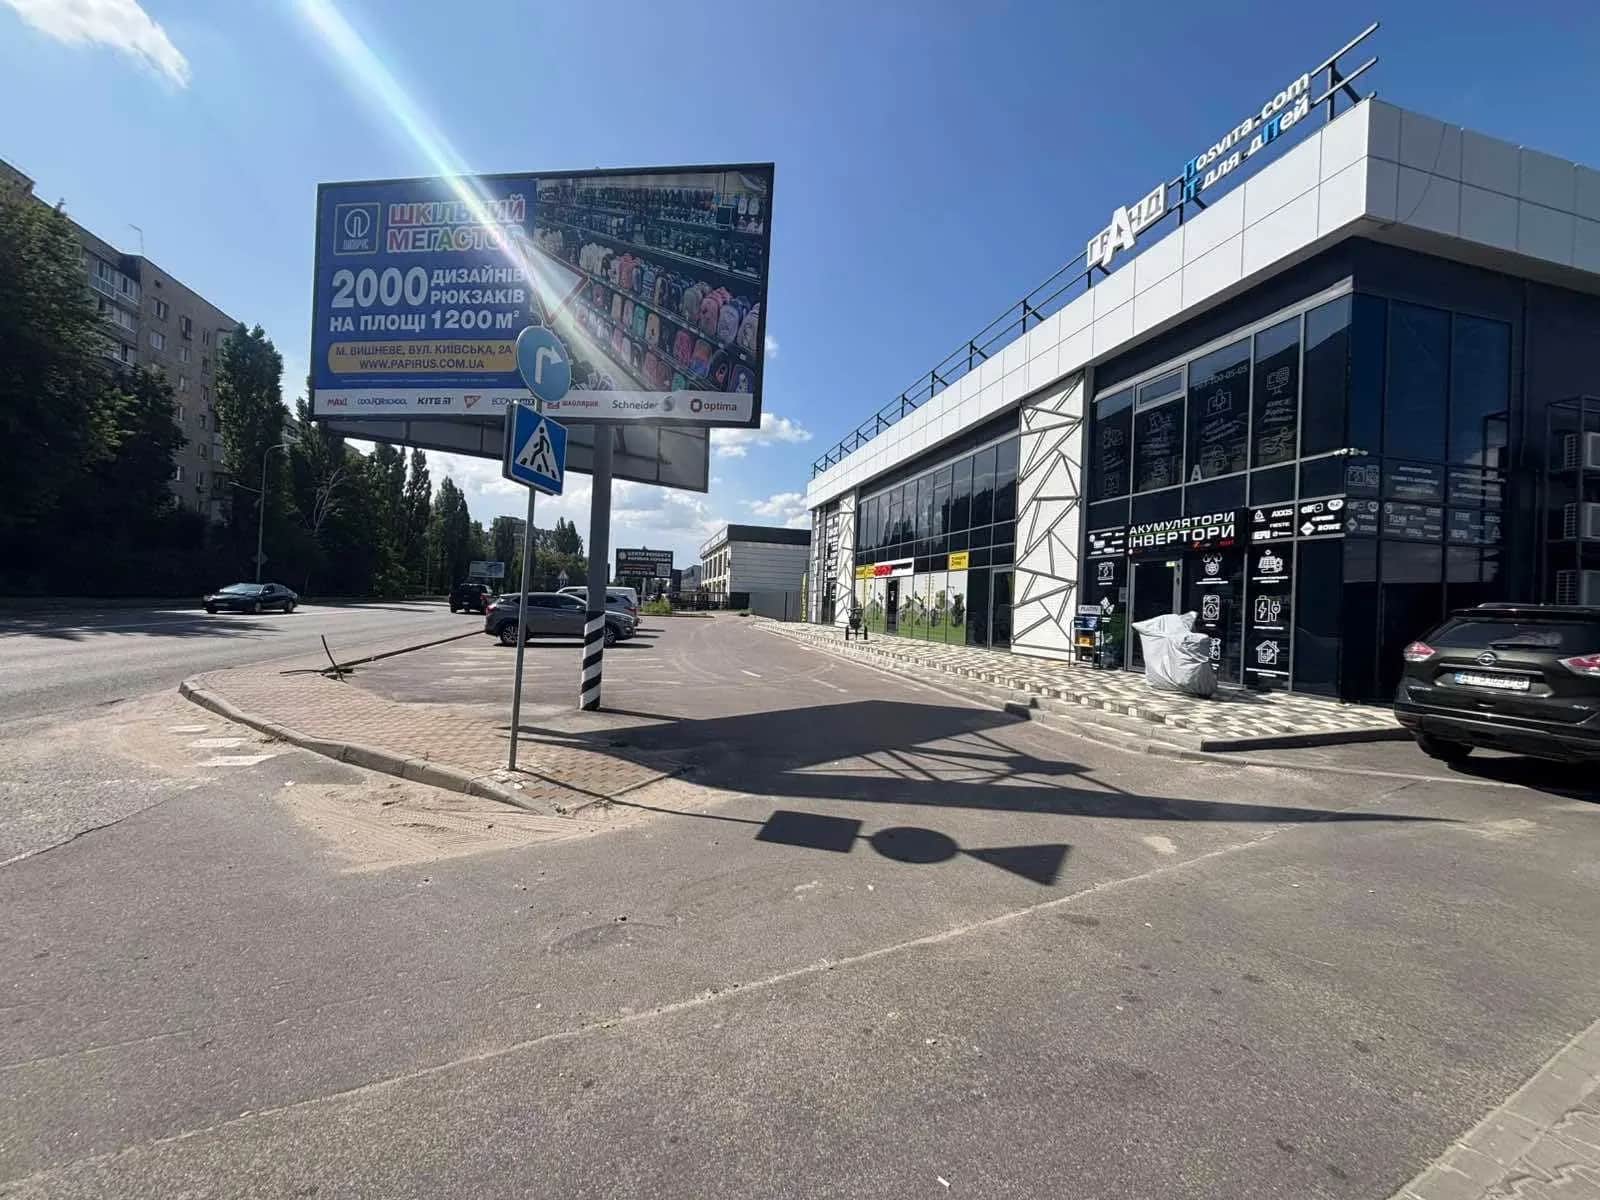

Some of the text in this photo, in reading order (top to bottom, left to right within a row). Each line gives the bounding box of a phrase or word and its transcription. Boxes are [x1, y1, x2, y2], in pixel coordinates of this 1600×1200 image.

[1202, 151, 1241, 190] для
[331, 266, 428, 308] 2000
[430, 265, 525, 287] ДИЗАЙНІВ
[430, 288, 525, 305] РЮКЗАКІВ
[329, 316, 354, 332] НА
[360, 314, 426, 332] ПЛОЩІ
[431, 309, 492, 329] 1200
[359, 357, 485, 370] WWW.PAPIRUS.COM.UA
[611, 399, 659, 410] Schneider
[703, 401, 737, 412] optima
[1129, 511, 1235, 536] АКУМУЛЯТОРИ
[1128, 524, 1235, 549] ІНВЕРТОРИ
